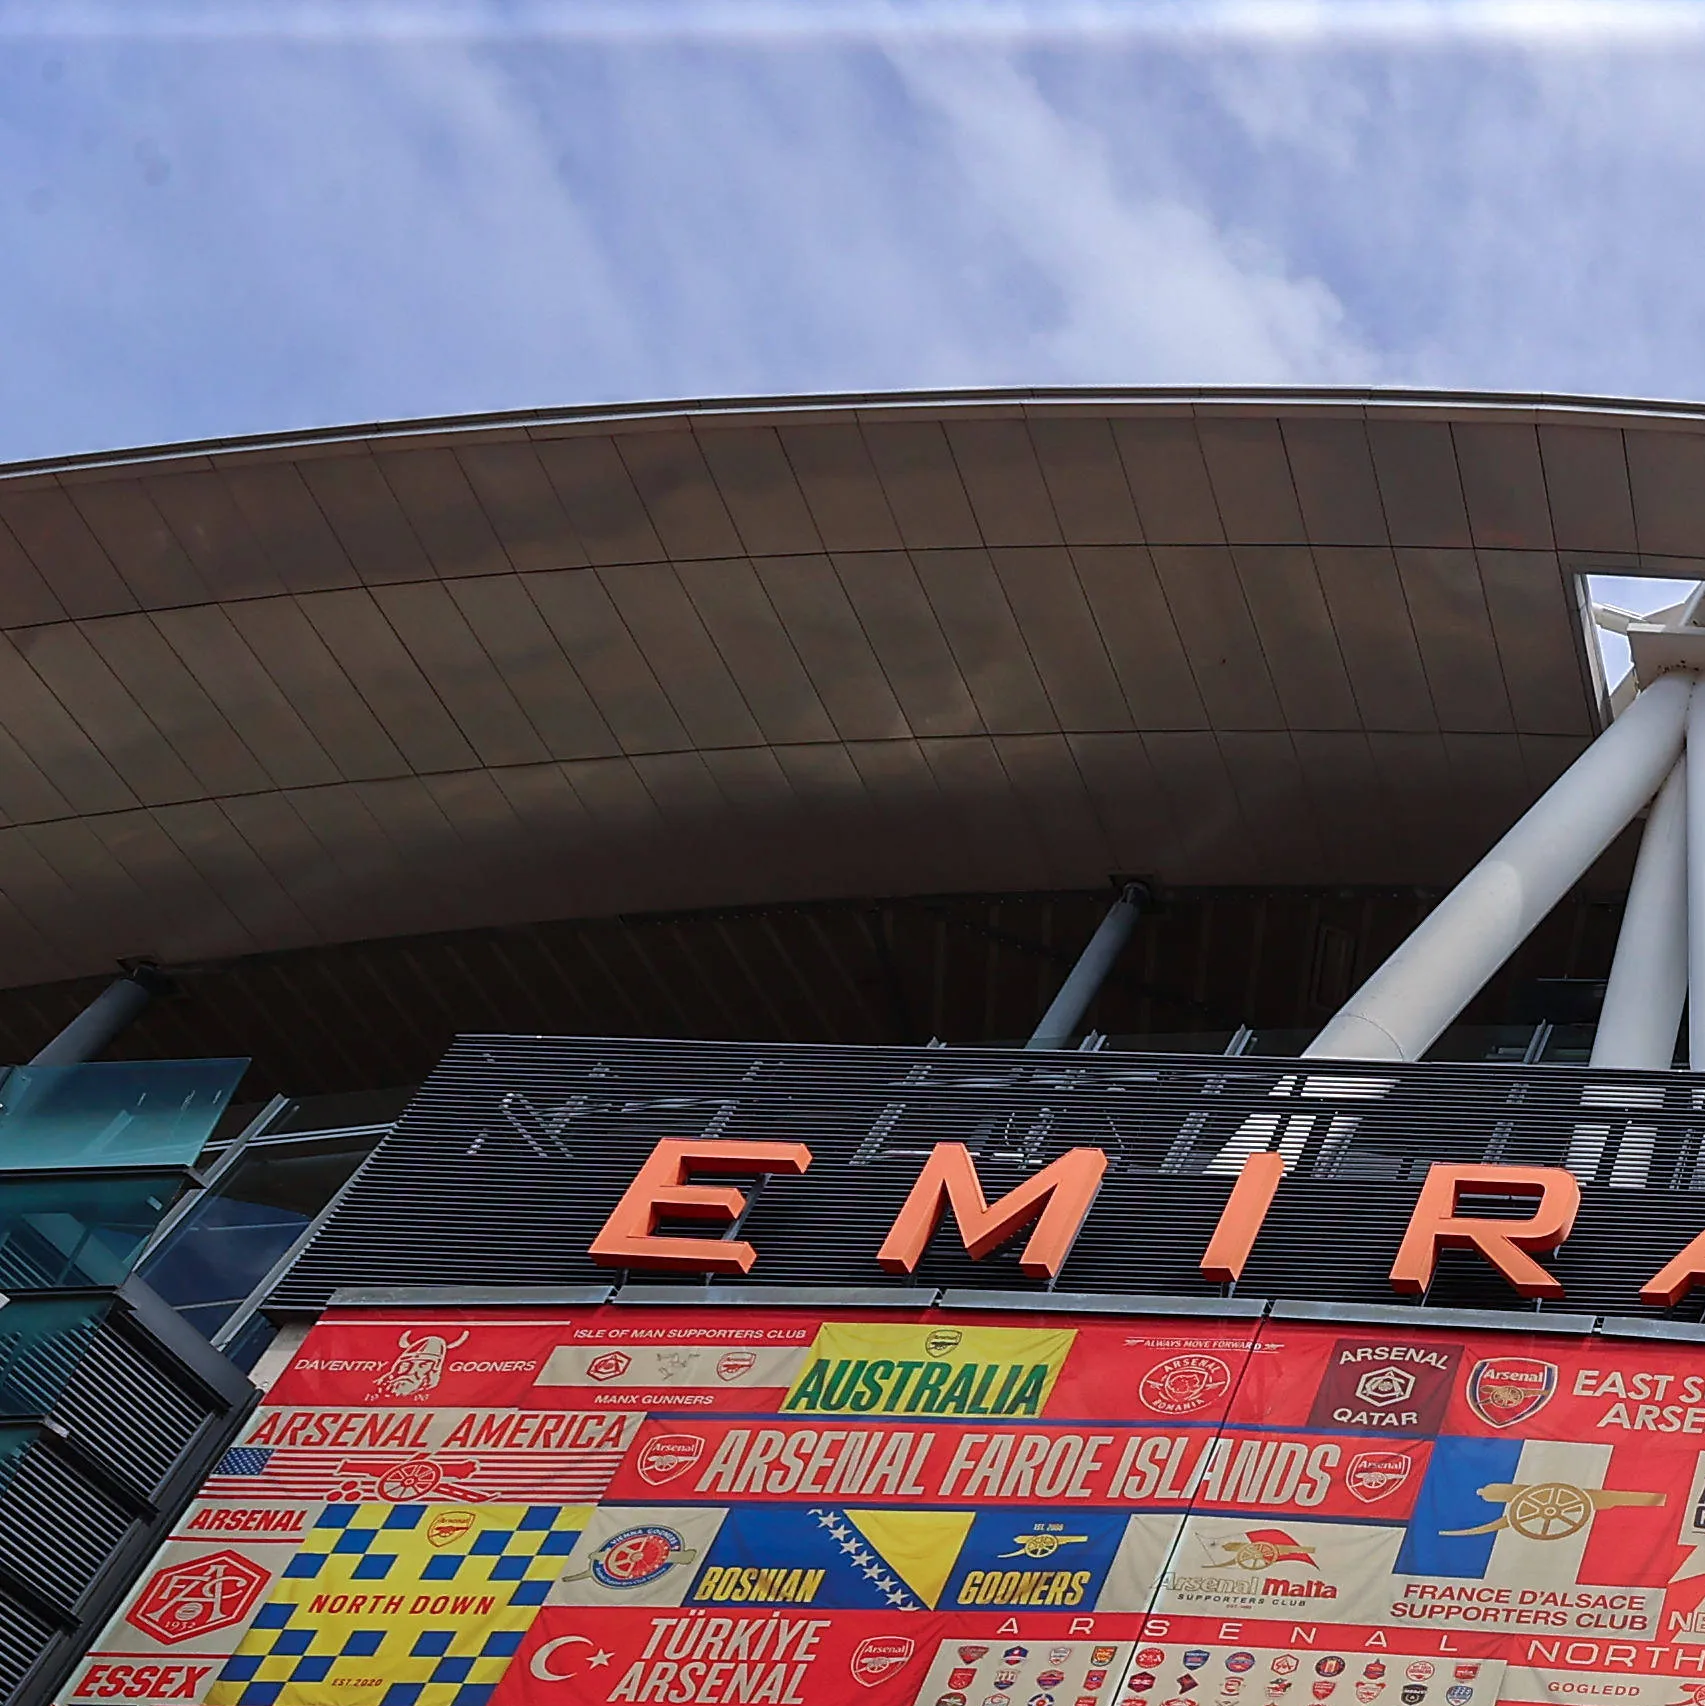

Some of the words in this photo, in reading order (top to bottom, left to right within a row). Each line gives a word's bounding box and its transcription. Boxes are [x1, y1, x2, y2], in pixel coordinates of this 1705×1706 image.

[295, 1359, 387, 1372] DAVENTRY
[449, 1359, 535, 1374] GOONERS
[781, 1358, 1049, 1416] AUSTRALIA
[1572, 1370, 1669, 1402] EAST
[244, 1413, 427, 1448] ARSENAL
[450, 1413, 627, 1448] AMERICA
[1332, 1407, 1419, 1427] QATAR
[696, 1431, 939, 1497] ARSENAL
[940, 1434, 1114, 1499] FAROE
[1107, 1435, 1340, 1507] ISLANDS
[694, 1567, 824, 1602] BOSNIAN
[649, 1610, 830, 1662] TÜRKİYE
[73, 1665, 213, 1697] ESSEX
[1547, 1682, 1641, 1697] GOGLEDD
